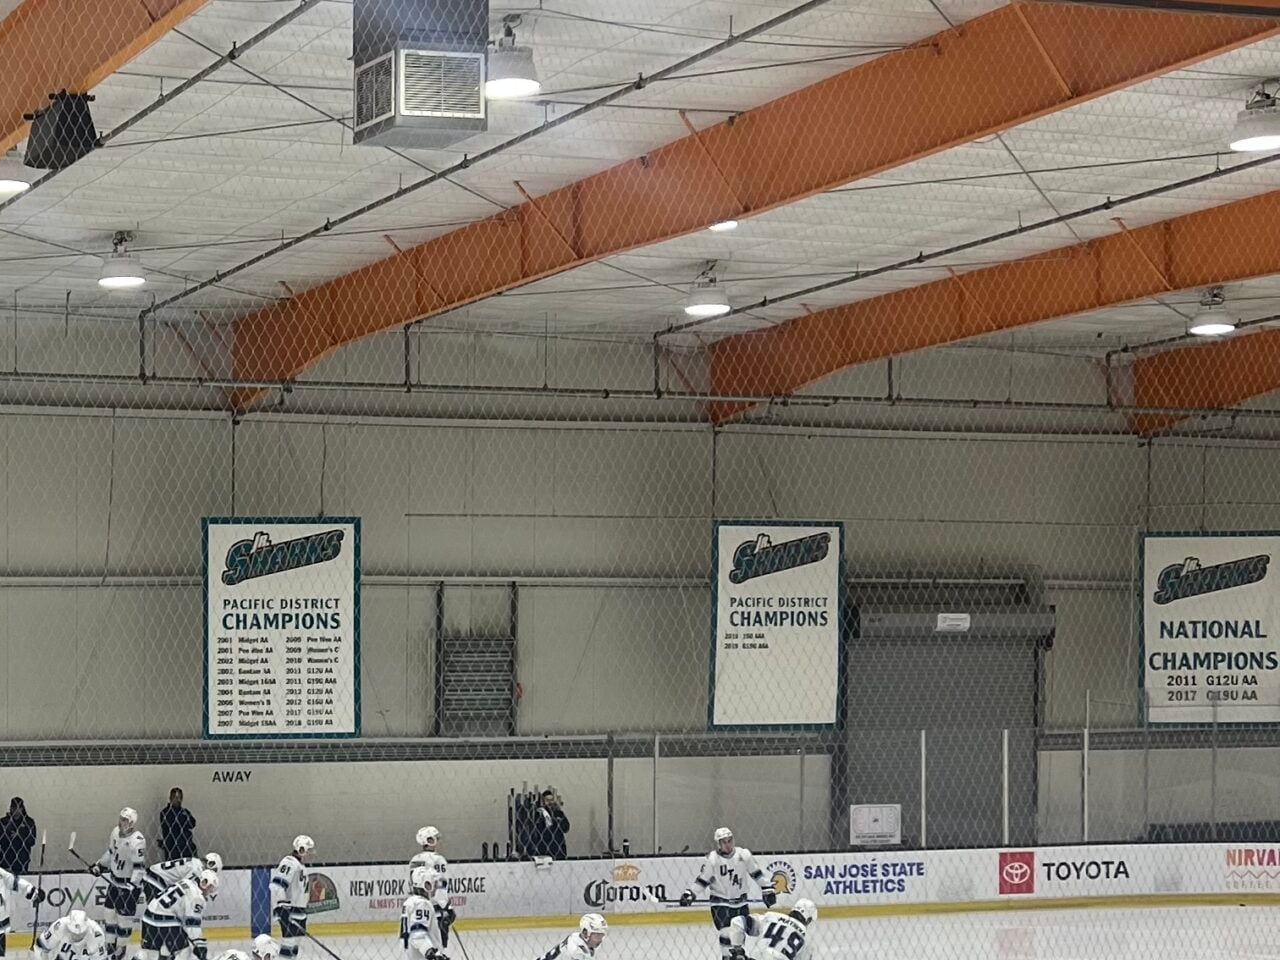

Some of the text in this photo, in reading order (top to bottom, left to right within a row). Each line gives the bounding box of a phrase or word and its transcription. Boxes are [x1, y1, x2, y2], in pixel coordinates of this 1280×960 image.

[223, 598, 340, 610] PACIFIC DISTRICT
[730, 597, 828, 608] PACIFIC DISTRICT
[222, 612, 341, 630] CHAMPIONS
[730, 610, 828, 627] CHAMPIONS
[1160, 620, 1267, 639] NATIONAL
[1149, 652, 1278, 670] CHAMPIONS
[1167, 675, 1258, 686] 2011 G12U AA
[1168, 691, 1196, 701] 2017
[1242, 691, 1258, 701] AA
[212, 771, 252, 783] AWAY
[1226, 849, 1280, 866] NIRVA
[803, 858, 924, 880] SAN JOSÉ STATE
[1043, 861, 1130, 881] TOYOTA
[350, 881, 374, 897] NEW
[378, 880, 405, 896] YORK
[447, 877, 485, 893] AUSAGE
[584, 879, 666, 910] Corona
[824, 878, 906, 895] ATHLETICS
[764, 922, 805, 960] 49
